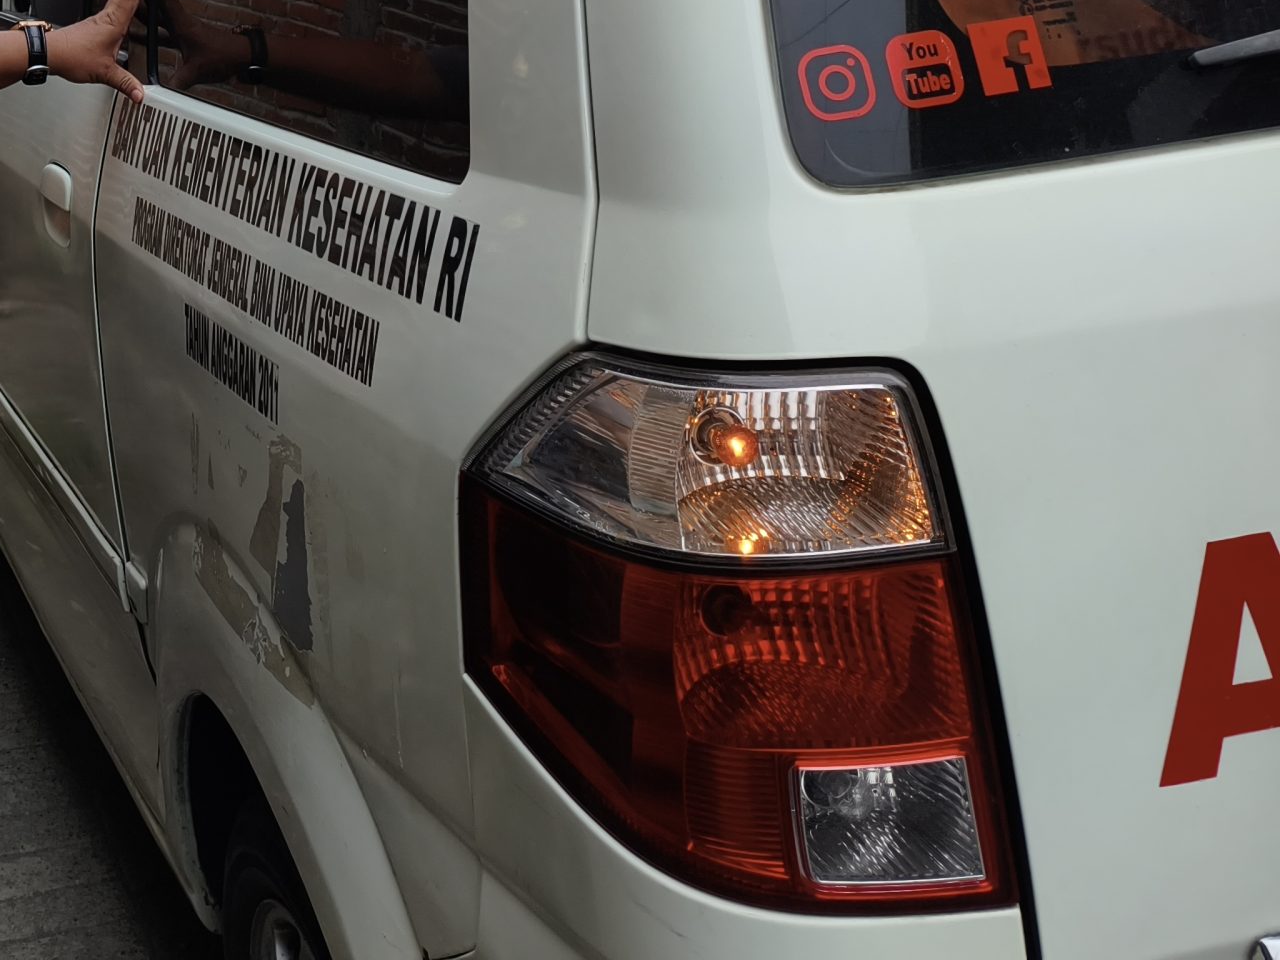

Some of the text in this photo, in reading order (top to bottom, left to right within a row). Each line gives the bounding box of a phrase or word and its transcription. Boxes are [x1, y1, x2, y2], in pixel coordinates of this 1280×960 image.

[902, 42, 939, 61] You
[906, 69, 951, 95] Tube
[170, 117, 296, 238] KEMENTERIAN
[287, 162, 441, 305] KESEHATAN
[433, 215, 481, 323] RI
[131, 196, 380, 387] PROGRAM DIREKTORAT JENDERAL BINA UPAYA KESEHATAN
[184, 302, 280, 426] TAHUN ANGGARAN 2011
